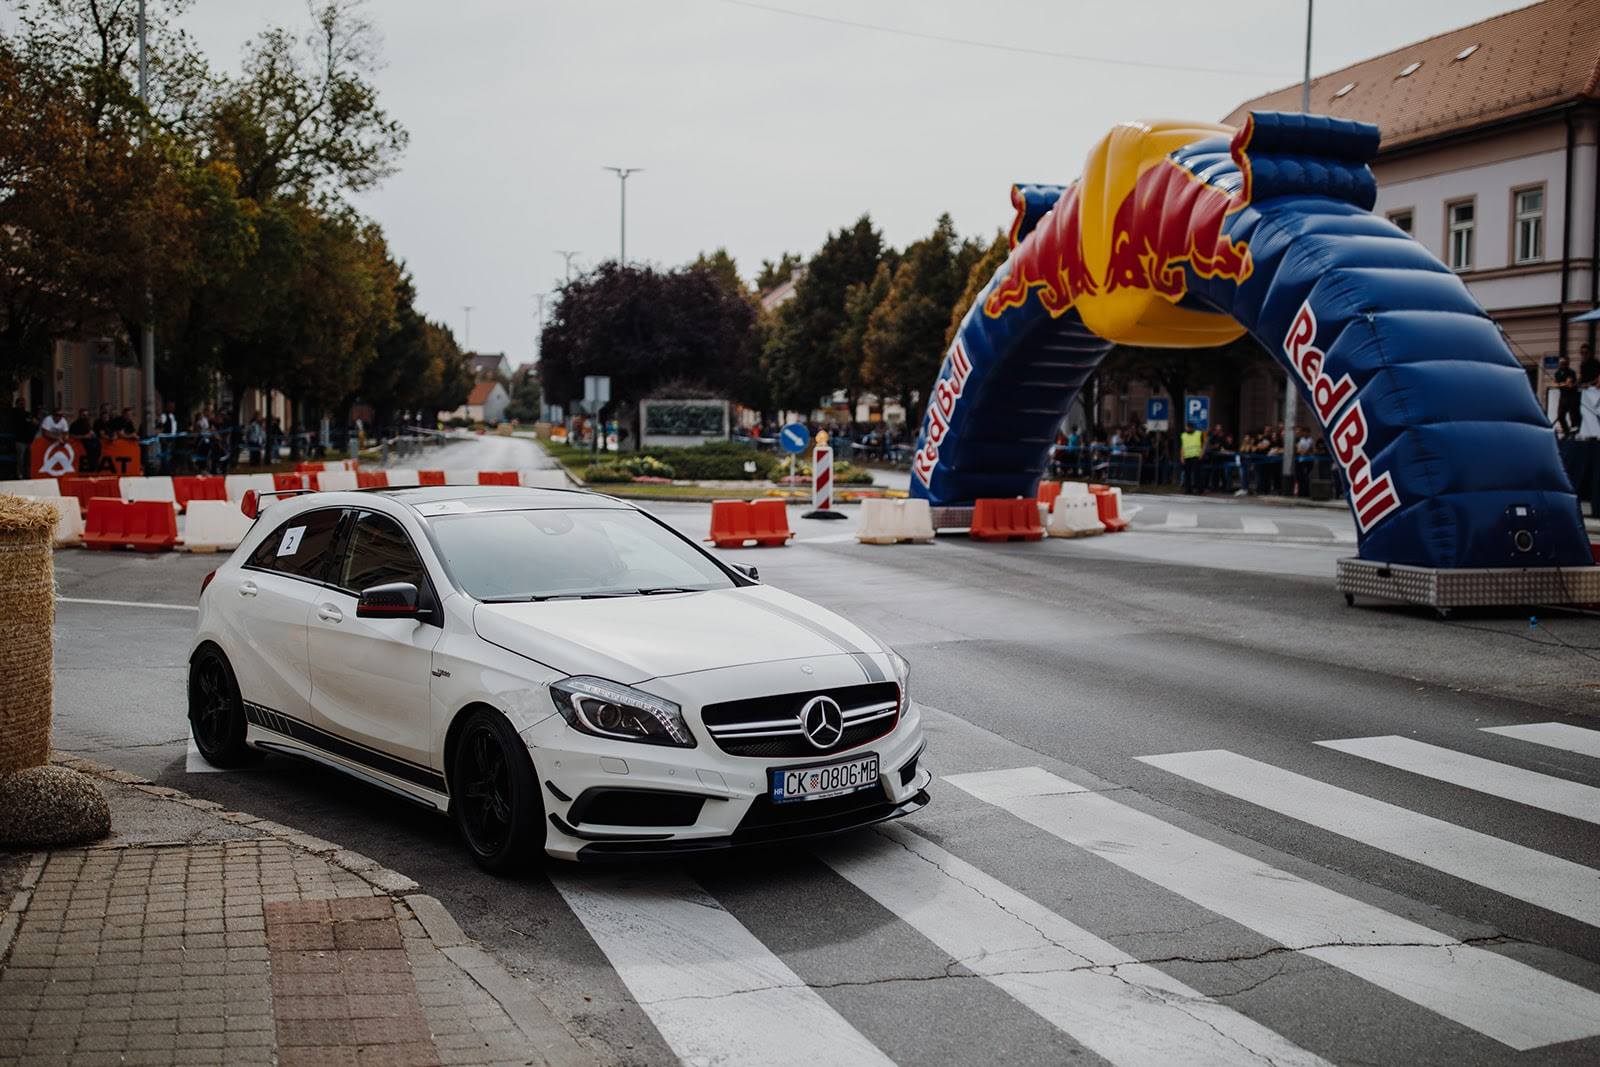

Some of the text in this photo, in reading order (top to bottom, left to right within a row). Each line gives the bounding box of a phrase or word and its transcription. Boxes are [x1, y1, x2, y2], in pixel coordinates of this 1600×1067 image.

[914, 340, 972, 487] Red Bull
[1152, 401, 1163, 416] P
[1189, 399, 1202, 416] P
[1284, 302, 1399, 531] Red Bull
[285, 536, 294, 550] 2
